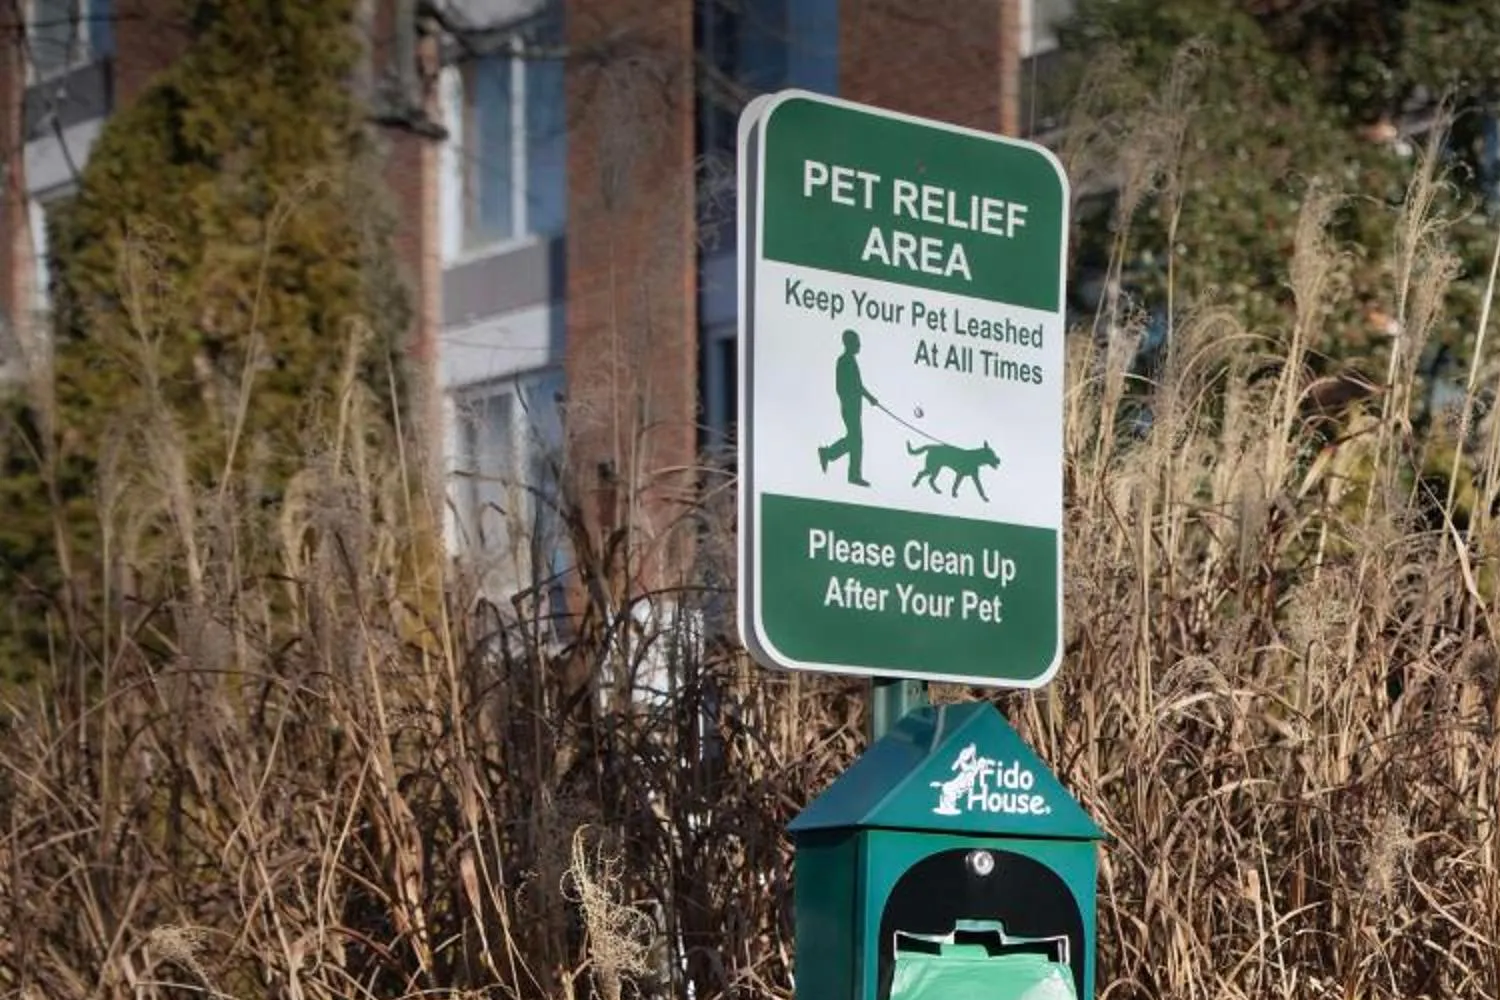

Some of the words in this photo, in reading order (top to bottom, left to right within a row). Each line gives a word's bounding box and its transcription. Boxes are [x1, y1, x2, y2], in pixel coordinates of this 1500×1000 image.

[803, 159, 880, 209] PET
[893, 179, 1028, 238] RELIEF
[861, 227, 972, 281] AREA
[785, 278, 845, 319] Keep
[851, 290, 904, 324] Your
[912, 302, 947, 332] Pet
[954, 309, 1043, 348] Leashed
[914, 340, 938, 368] At
[944, 343, 973, 373] All
[980, 350, 1043, 384] Times
[808, 528, 896, 568] Please
[903, 540, 974, 576] Clean
[982, 550, 1016, 588] Up
[824, 576, 889, 611] After
[897, 583, 954, 618] Your
[961, 590, 1002, 623] Pet
[980, 758, 1034, 790] Fido
